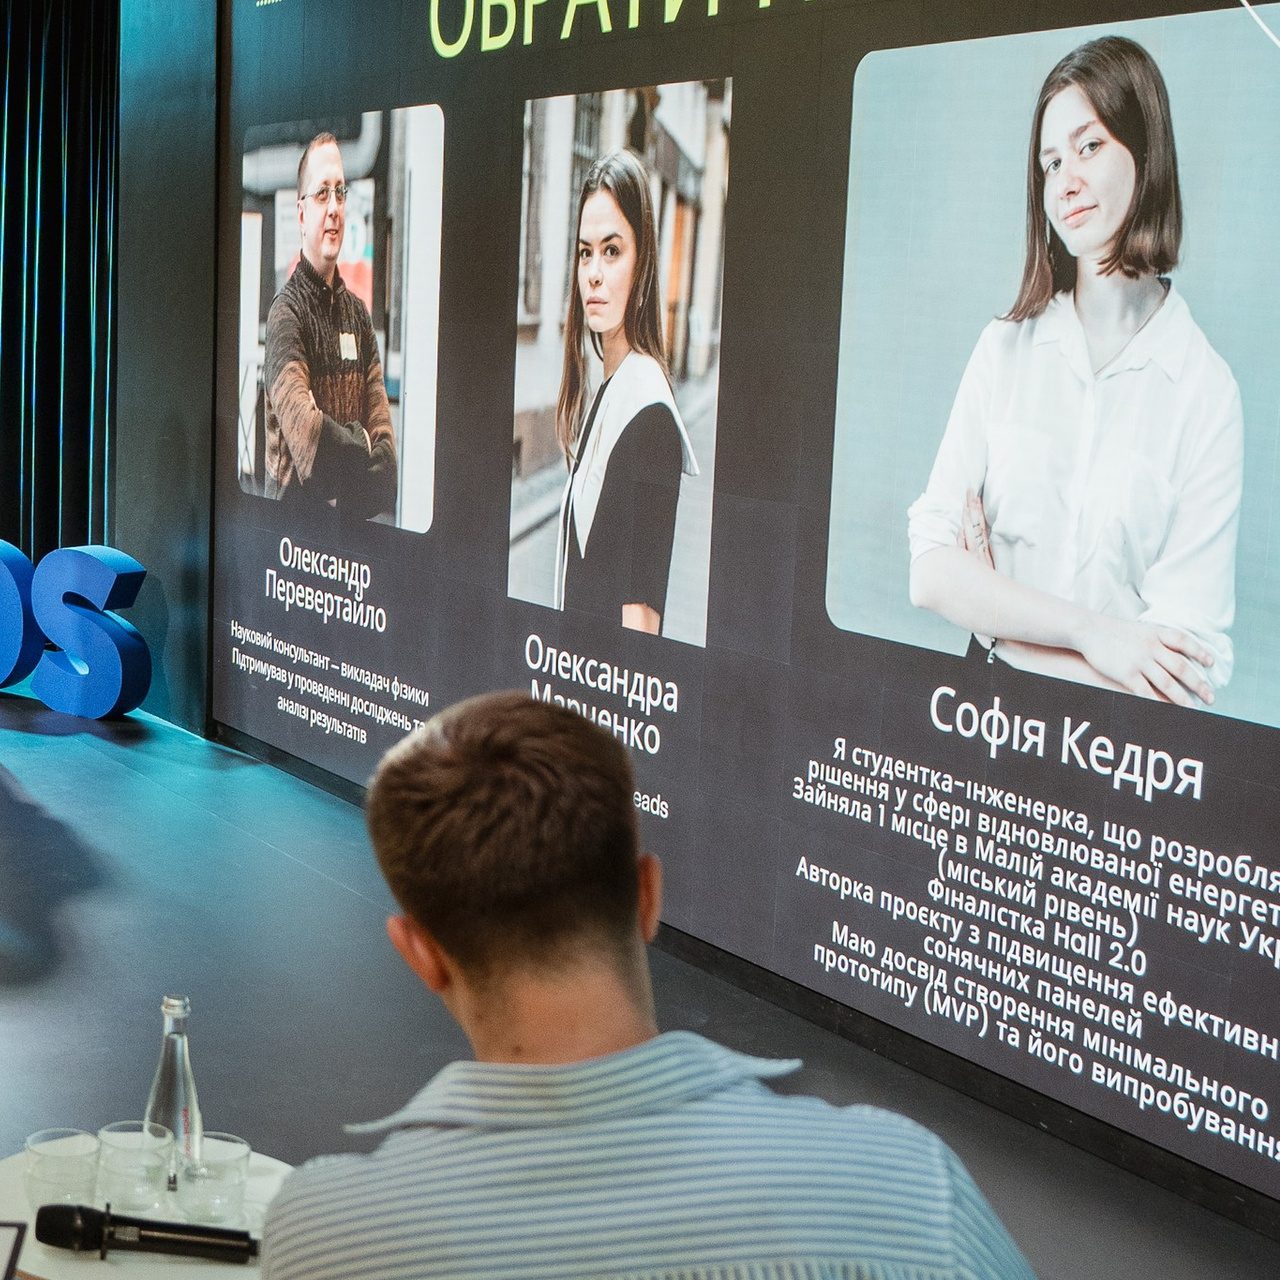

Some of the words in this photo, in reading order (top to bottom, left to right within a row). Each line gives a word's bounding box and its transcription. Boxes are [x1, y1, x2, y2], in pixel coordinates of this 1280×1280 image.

[265, 569, 387, 633] Перевертайло
[279, 537, 371, 595] Олександр
[231, 620, 272, 650] Науковий
[273, 637, 331, 671] консультант
[341, 662, 390, 693] викладач
[391, 676, 430, 708] фізики
[232, 647, 287, 683] Підтримував
[287, 672, 295, 690] у
[295, 674, 350, 708] проведенні
[351, 699, 412, 731] досліджень
[525, 634, 679, 716] Олександра
[277, 696, 308, 720] аналізі
[310, 708, 367, 745] результатів
[930, 686, 1046, 759] Софія
[1061, 717, 1205, 801] Кедря
[792, 777, 871, 822] Зайняла
[878, 804, 885, 827] 1
[891, 813, 948, 850] місце
[955, 834, 968, 854] в
[975, 835, 1044, 880] Малій
[1051, 866, 1160, 919] академії
[1167, 903, 1231, 944] наук
[808, 760, 889, 801] рішення
[894, 786, 907, 811] у
[913, 791, 971, 829] сфері
[978, 812, 1163, 889] відновлюваної
[1169, 873, 1280, 927] енергет
[833, 738, 846, 760] Я
[1103, 821, 1141, 852] що
[1150, 835, 1280, 894] розробля
[938, 847, 1036, 908] (міський
[1044, 893, 1138, 948] рівень)
[795, 856, 873, 904] Авторка
[880, 890, 963, 942] проєкту
[968, 924, 980, 944] з
[987, 932, 1135, 1005] підвищення
[1142, 990, 1279, 1060] ефективн
[923, 936, 1030, 994] сонячних
[1036, 979, 1143, 1039] панелей
[1053, 922, 1101, 961] Hall
[1108, 941, 1147, 976] 2.0
[813, 944, 918, 1008] прототипу
[924, 982, 988, 1038] (MVP)
[996, 1020, 1020, 1048] та
[1028, 1029, 1083, 1074] його
[832, 920, 876, 958] Маю
[880, 947, 947, 993] досвід
[954, 976, 1075, 1042] створення
[1083, 1027, 1269, 1122] мінімального
